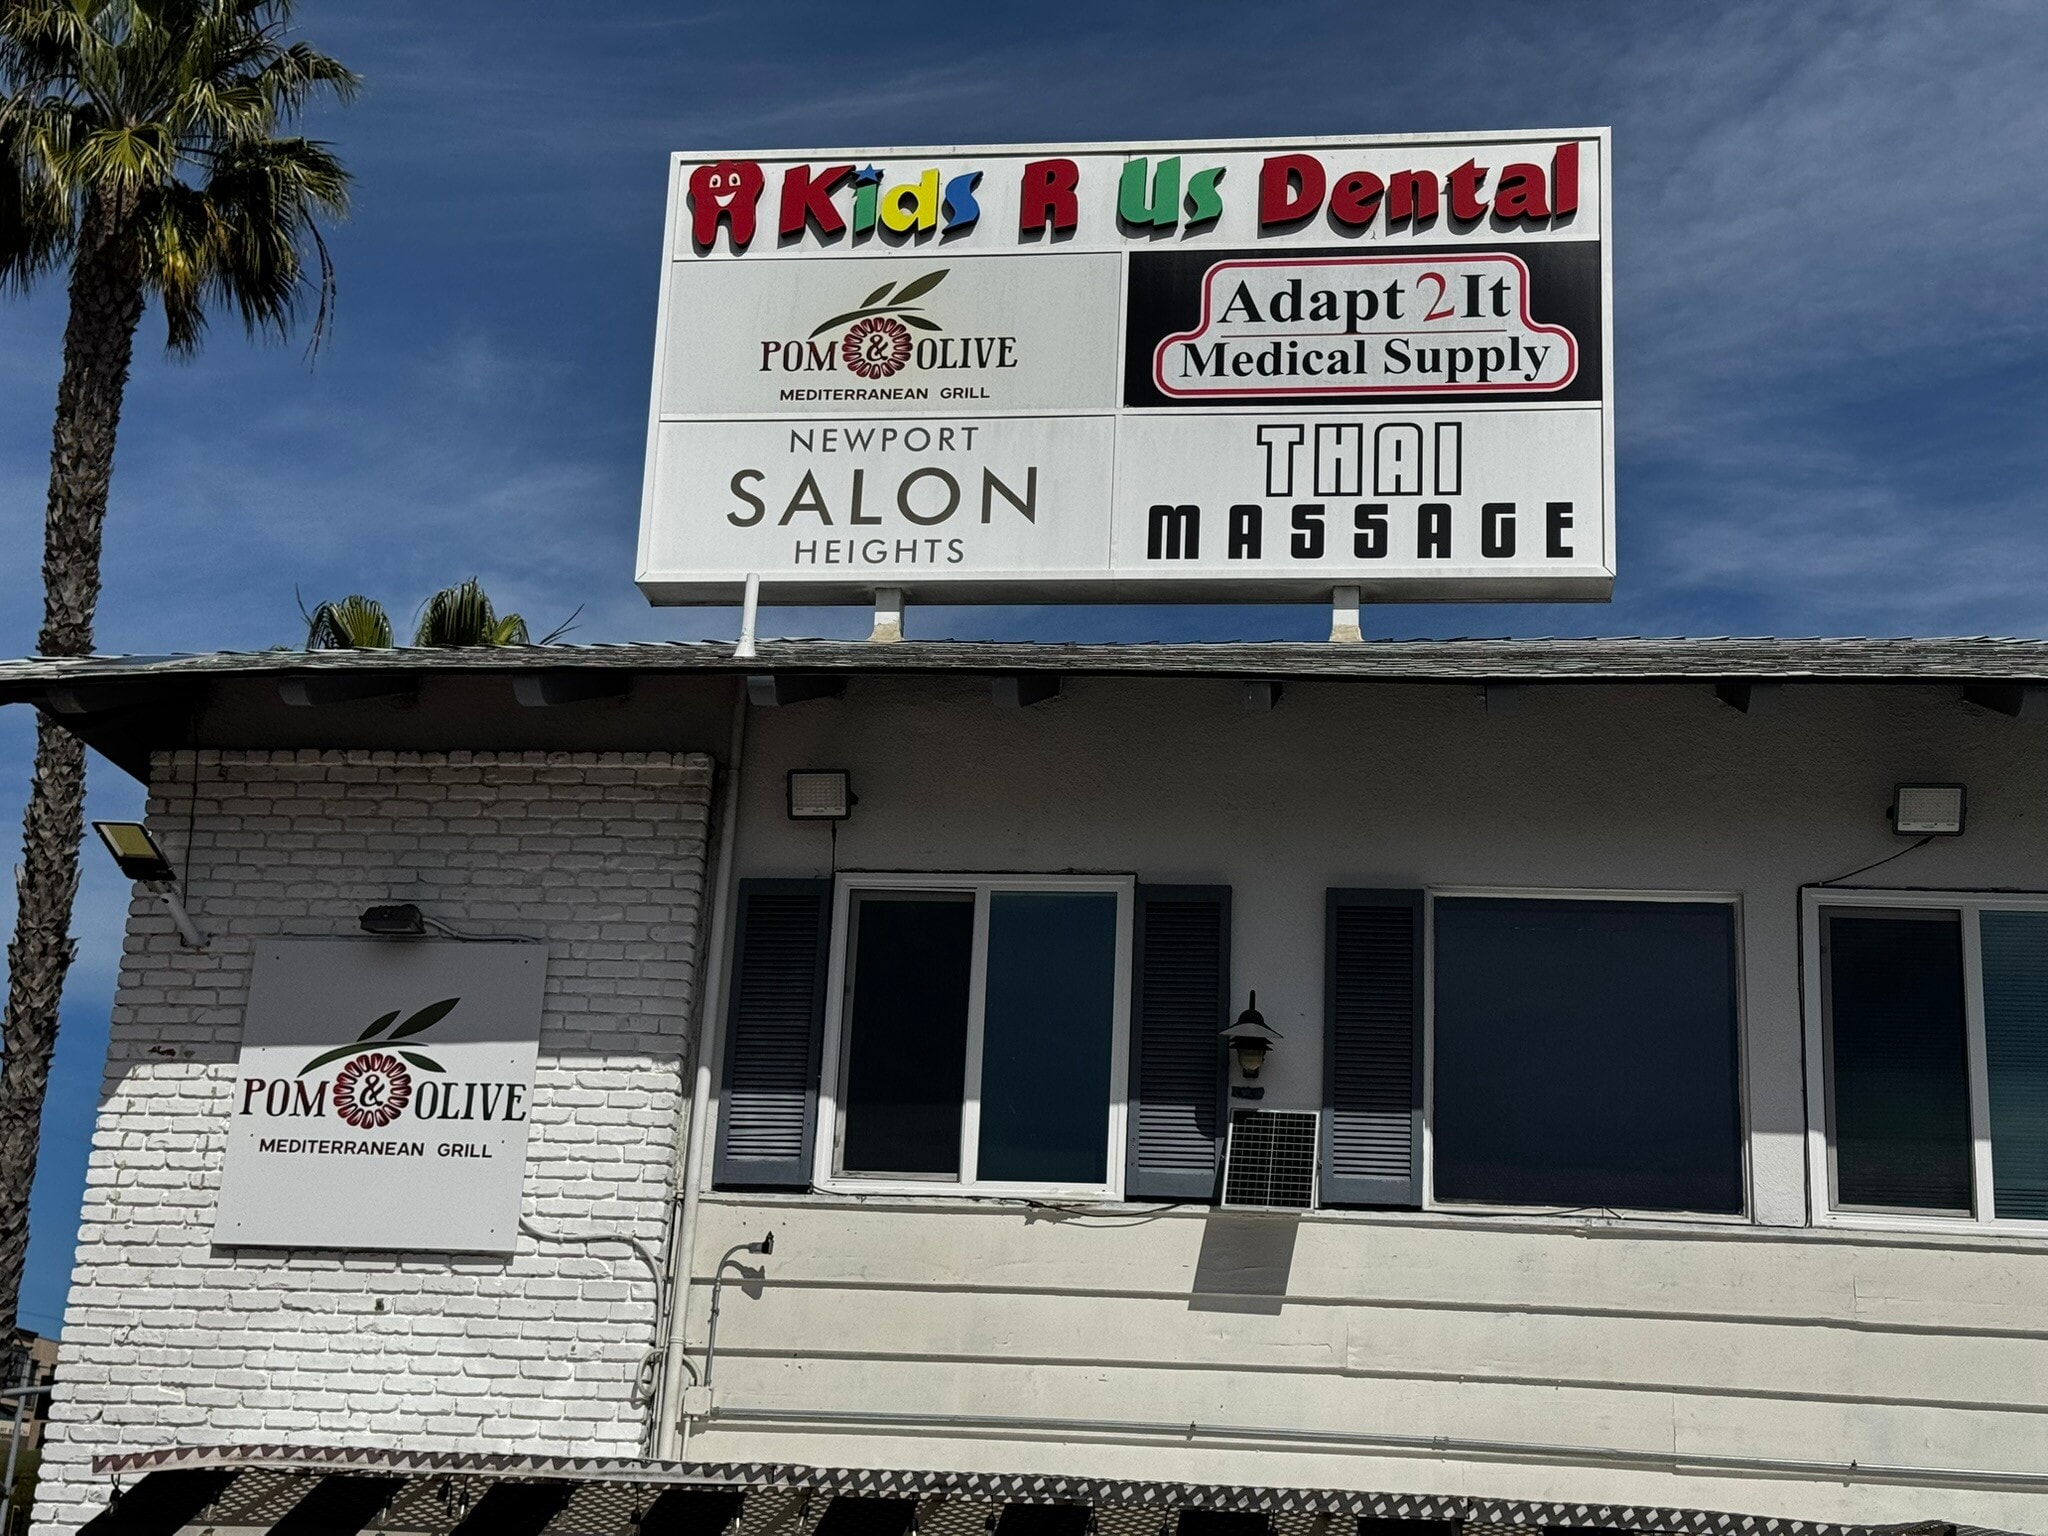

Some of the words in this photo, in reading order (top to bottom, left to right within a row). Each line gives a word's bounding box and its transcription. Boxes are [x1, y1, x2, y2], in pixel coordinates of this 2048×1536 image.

[779, 162, 983, 236] Kids
[1020, 158, 1080, 233] R
[1118, 155, 1226, 230] Us
[1261, 141, 1579, 228] Dental
[1217, 278, 1405, 334] Adapt
[759, 340, 838, 371] POM
[866, 334, 889, 361] &
[916, 336, 1018, 370] OLIVE
[1179, 339, 1367, 378] Medical
[1384, 336, 1552, 384] Supply
[779, 387, 929, 401] MEDITERRANEAN
[940, 386, 991, 400] GRILL
[790, 427, 980, 453] NEWPORT
[1256, 422, 1462, 497] THAI
[726, 466, 1038, 527] SALON
[794, 538, 965, 564] HEIGHTS
[1147, 502, 1573, 560] MASSAGE
[239, 1078, 330, 1117] POM
[360, 1074, 385, 1107] &
[414, 1081, 527, 1121] OLIVE
[259, 1138, 425, 1157] MEDITERRANEAN
[437, 1143, 493, 1158] GRILL
